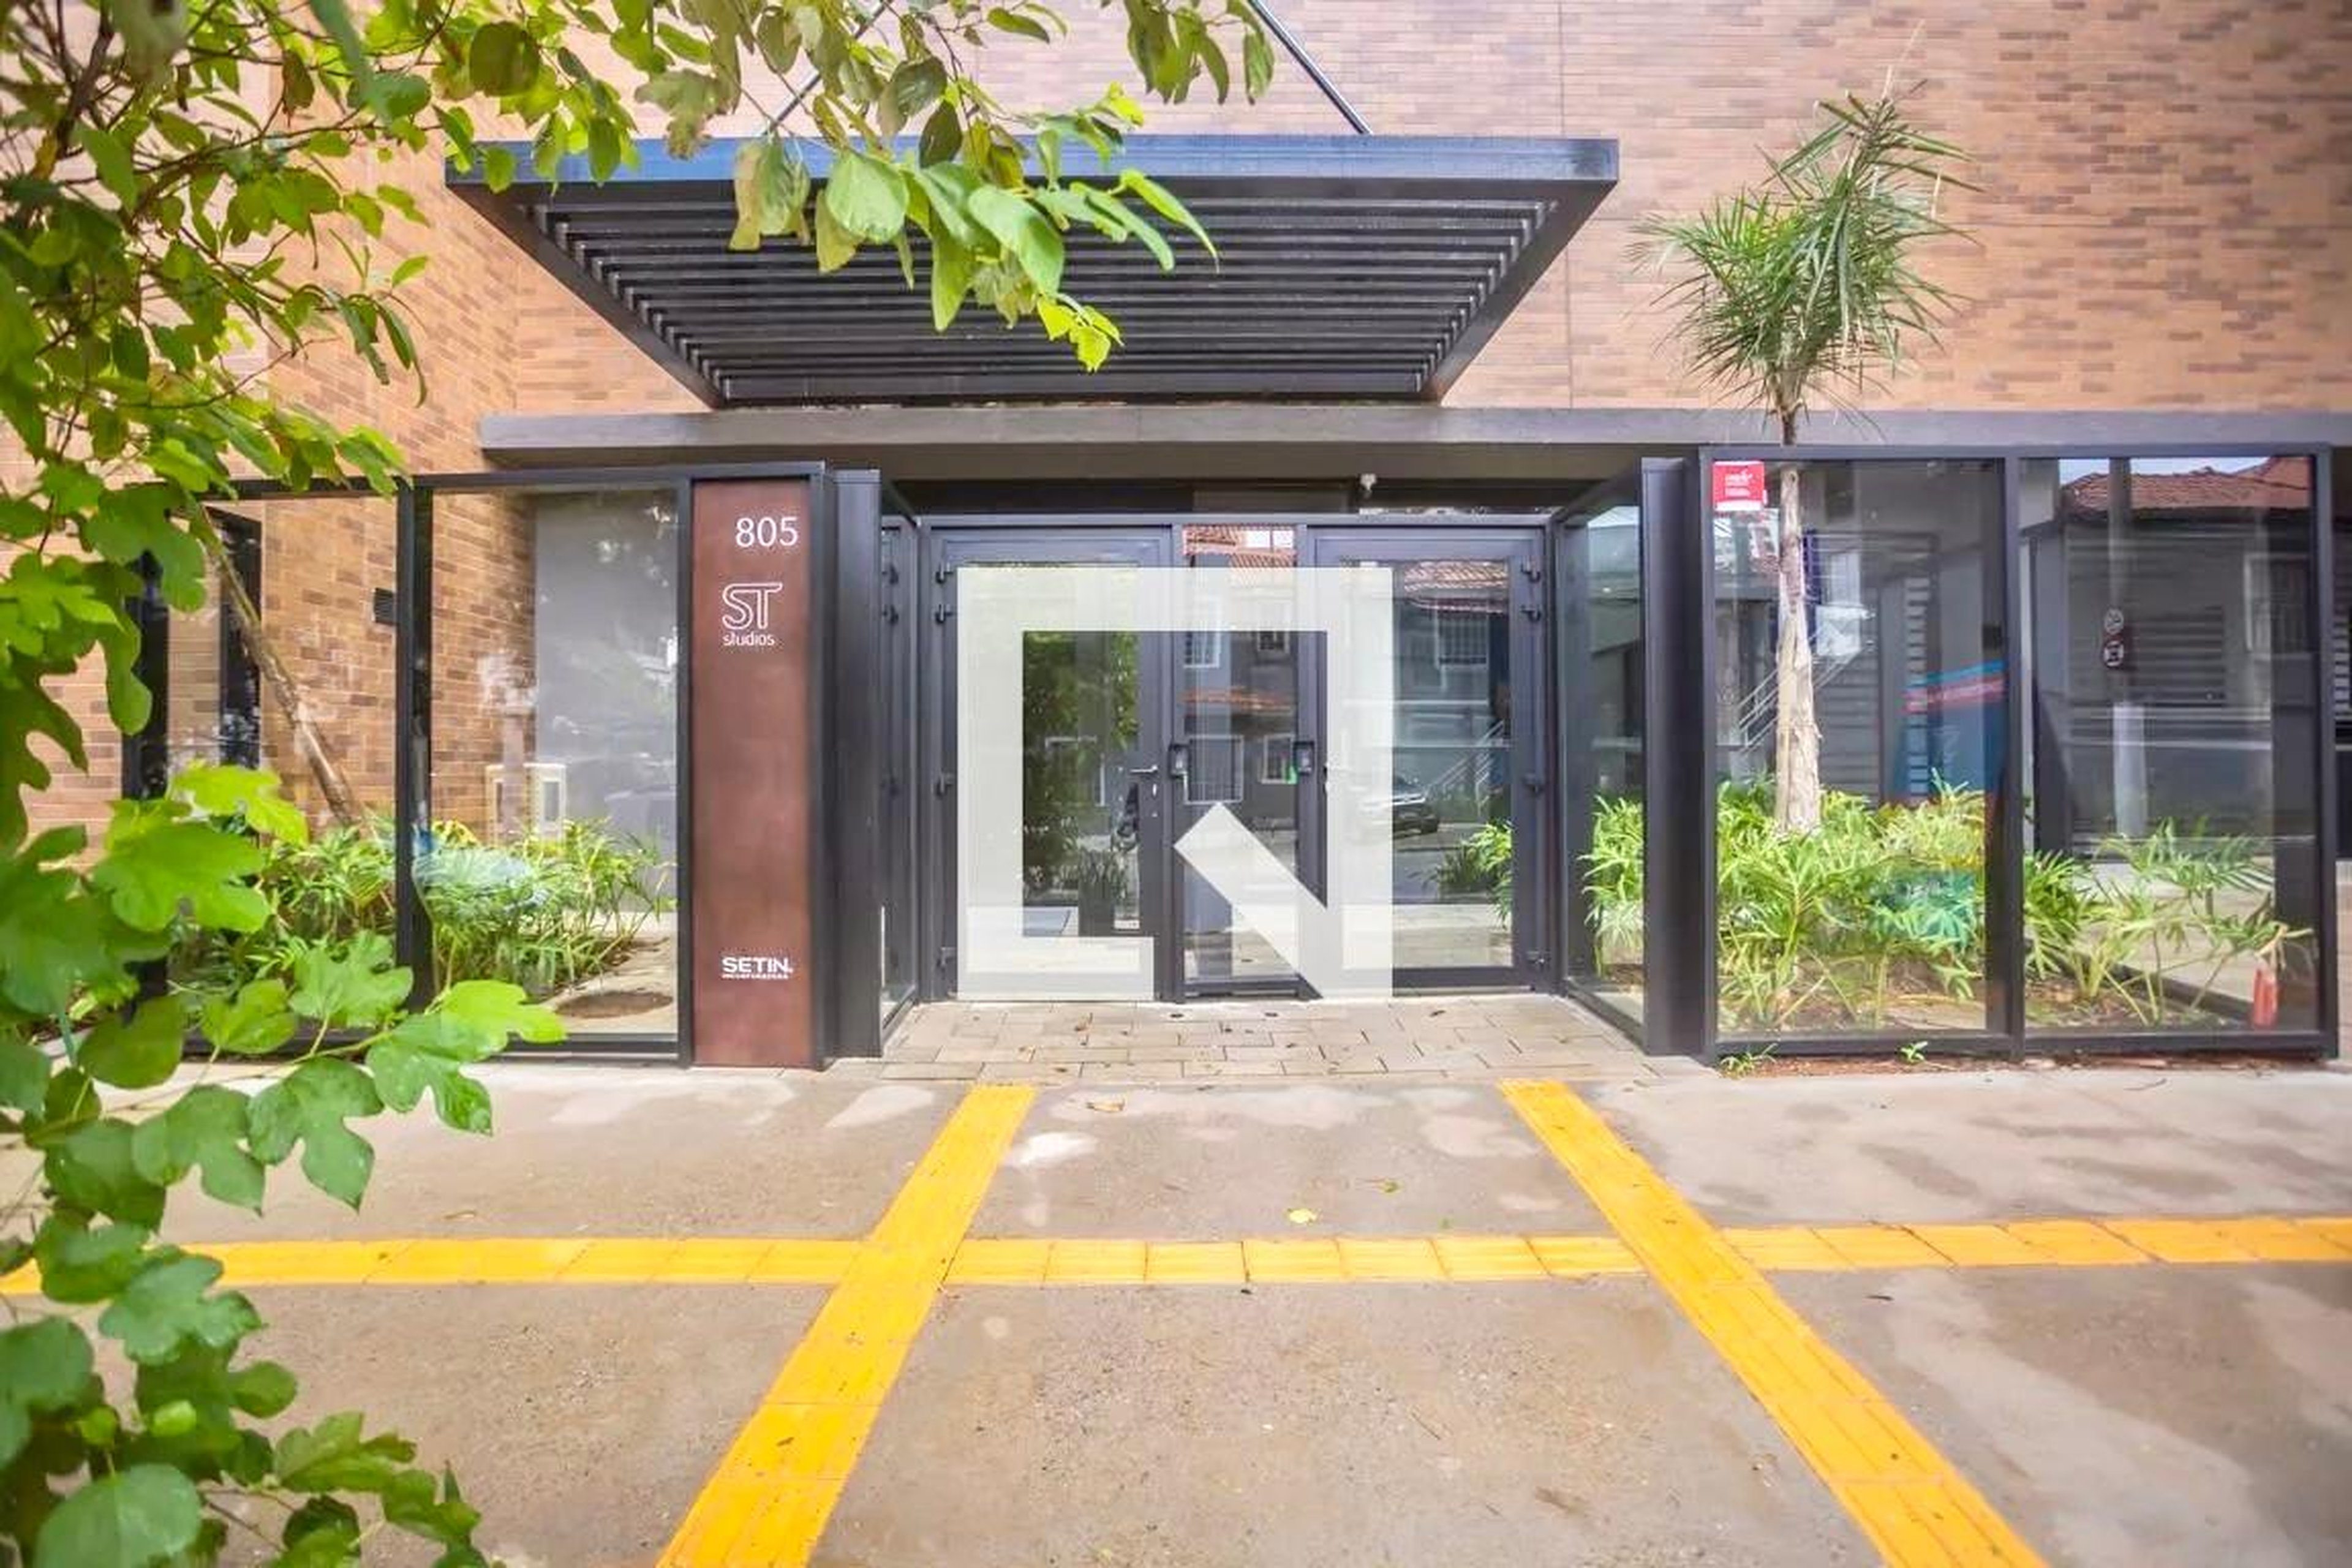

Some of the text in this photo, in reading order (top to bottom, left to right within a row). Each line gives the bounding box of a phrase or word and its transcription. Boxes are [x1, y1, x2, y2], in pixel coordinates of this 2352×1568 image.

[736, 516, 798, 547] 805
[722, 582, 783, 630] ST
[722, 631, 775, 646] studios
